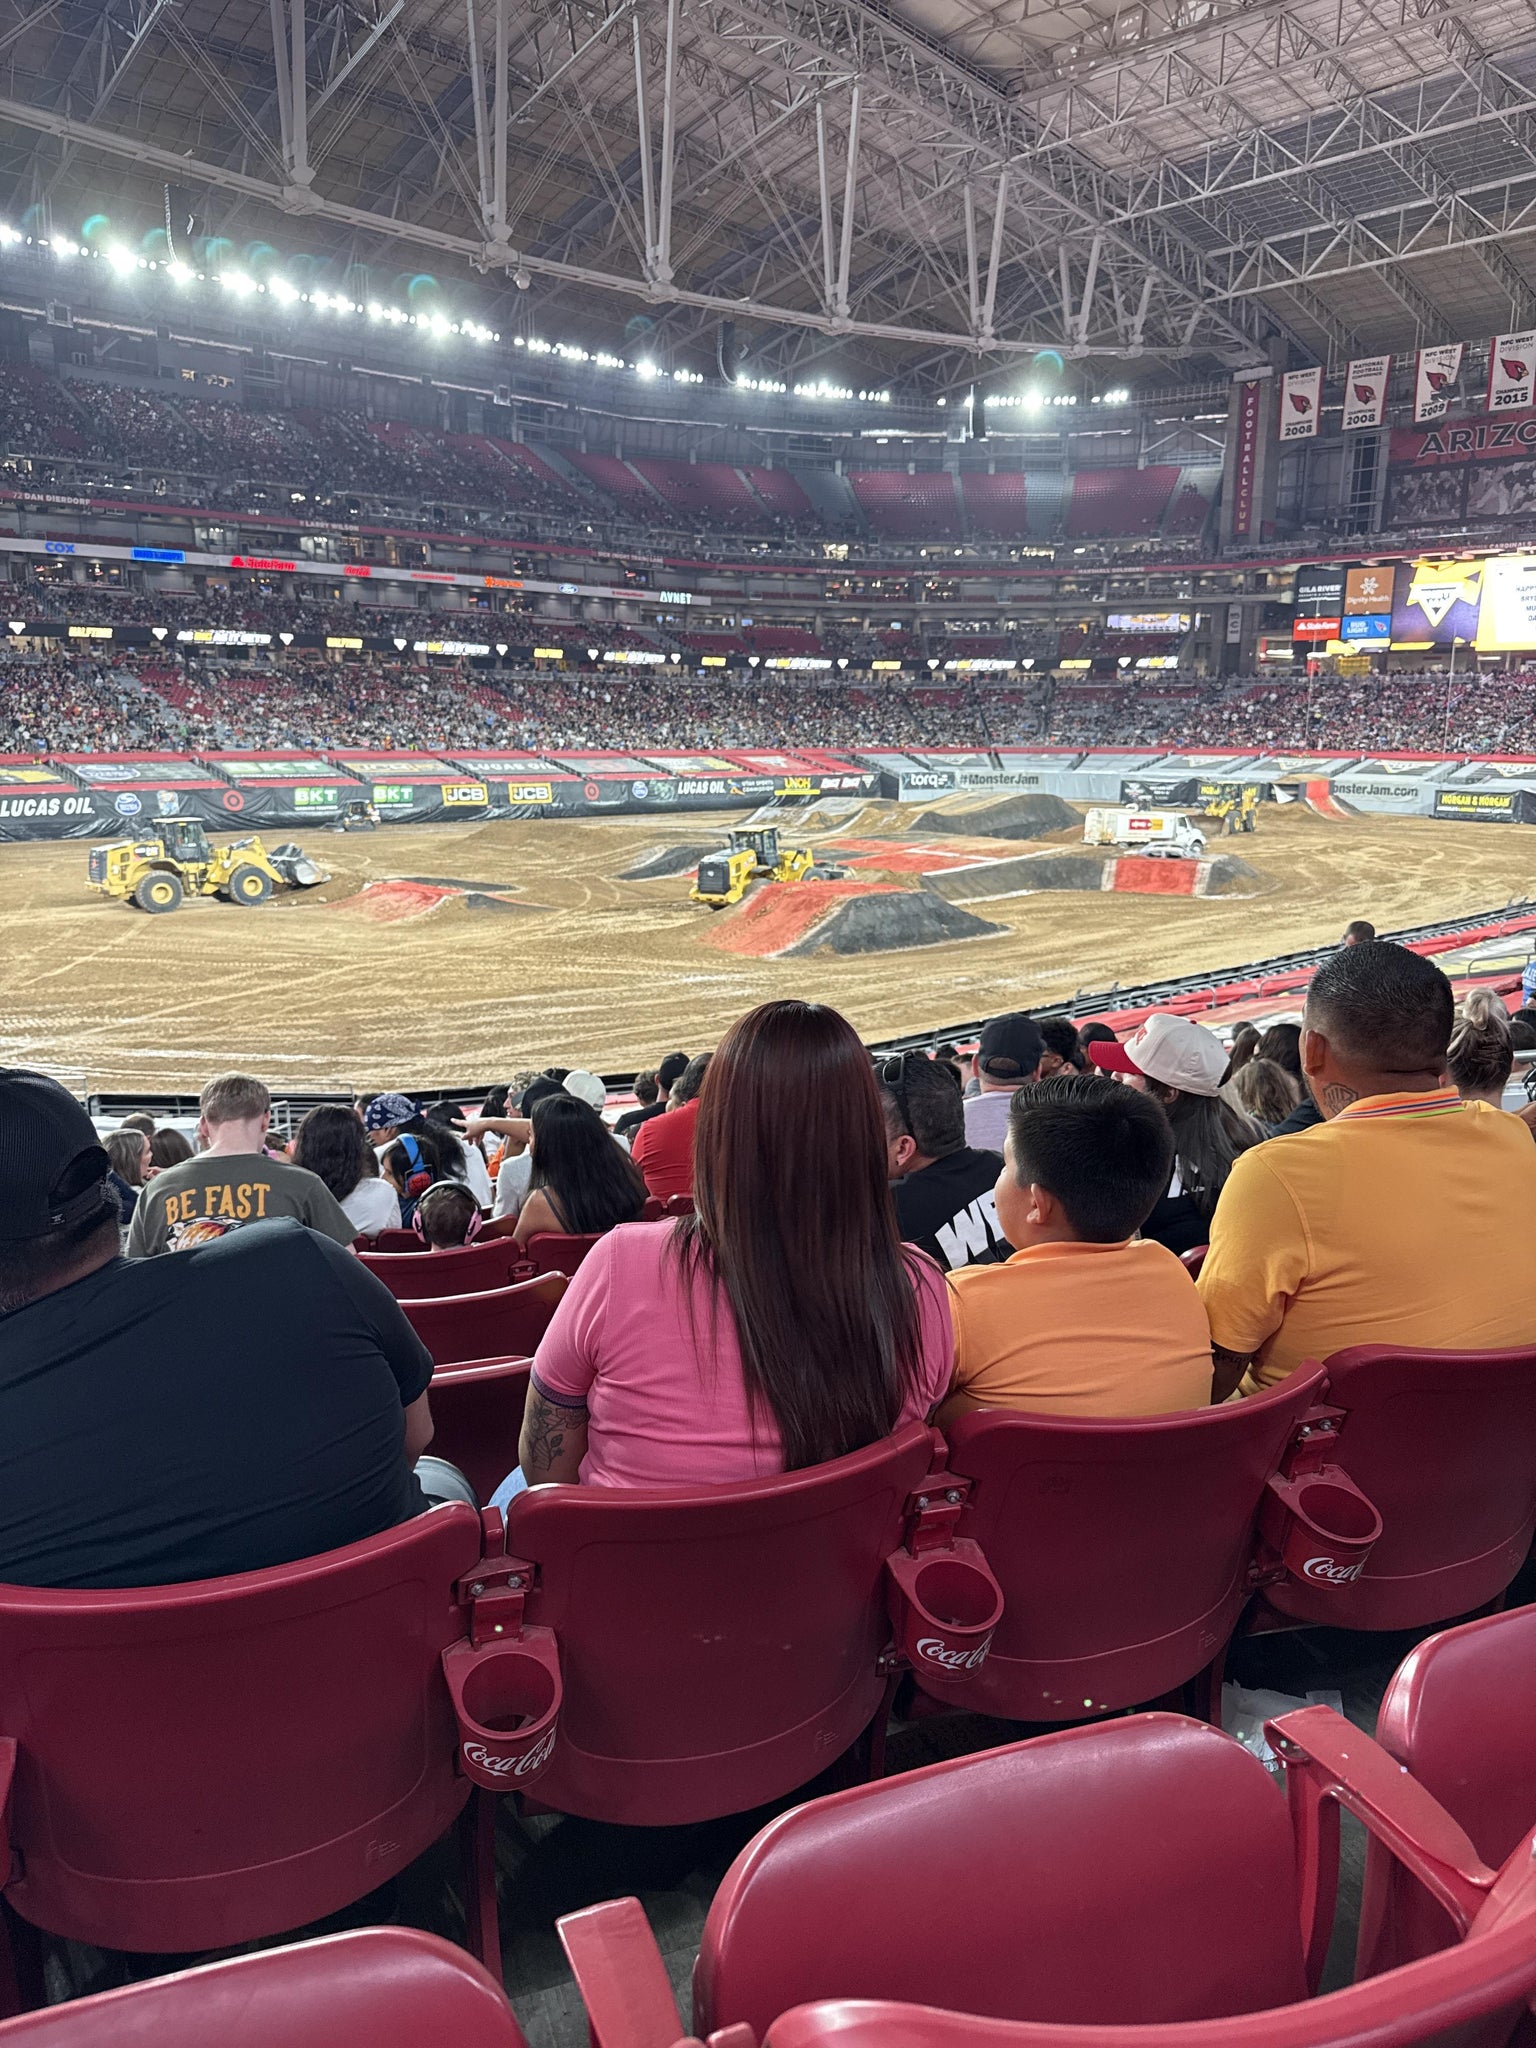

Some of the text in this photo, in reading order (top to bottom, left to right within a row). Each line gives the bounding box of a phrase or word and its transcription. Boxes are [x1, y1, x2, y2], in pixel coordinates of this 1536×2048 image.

[1500, 336, 1535, 346] NFC WEST
[1500, 343, 1534, 353] DIVISION
[1424, 354, 1457, 365] DIVISION
[1496, 386, 1528, 394] CHAMPIONS
[1494, 392, 1528, 406] 2015
[1420, 403, 1445, 418] 2009
[1346, 414, 1376, 425] 2008
[1284, 425, 1313, 437] 2008
[1242, 397, 1254, 486] FOOTBALL
[24, 493, 44, 502] DAN
[45, 494, 91, 506] DIERDORF
[45, 542, 75, 553] COX
[1489, 541, 1532, 550] CARDINALS
[1299, 584, 1342, 593] GILA RIVER
[1346, 596, 1368, 605] Dignity
[959, 774, 1039, 785] #MonsterJam
[374, 786, 413, 801] BKT
[447, 787, 485, 802] JCB
[513, 787, 549, 801] JCB
[677, 782, 709, 795] LUCAS
[1333, 784, 1418, 797] onsterJam.com
[295, 788, 338, 804] BKT
[1441, 794, 1471, 806] MORGAN
[1479, 795, 1511, 808] MORGAN
[0, 798, 60, 818] LUCAS
[165, 1183, 271, 1226] BE FAST
